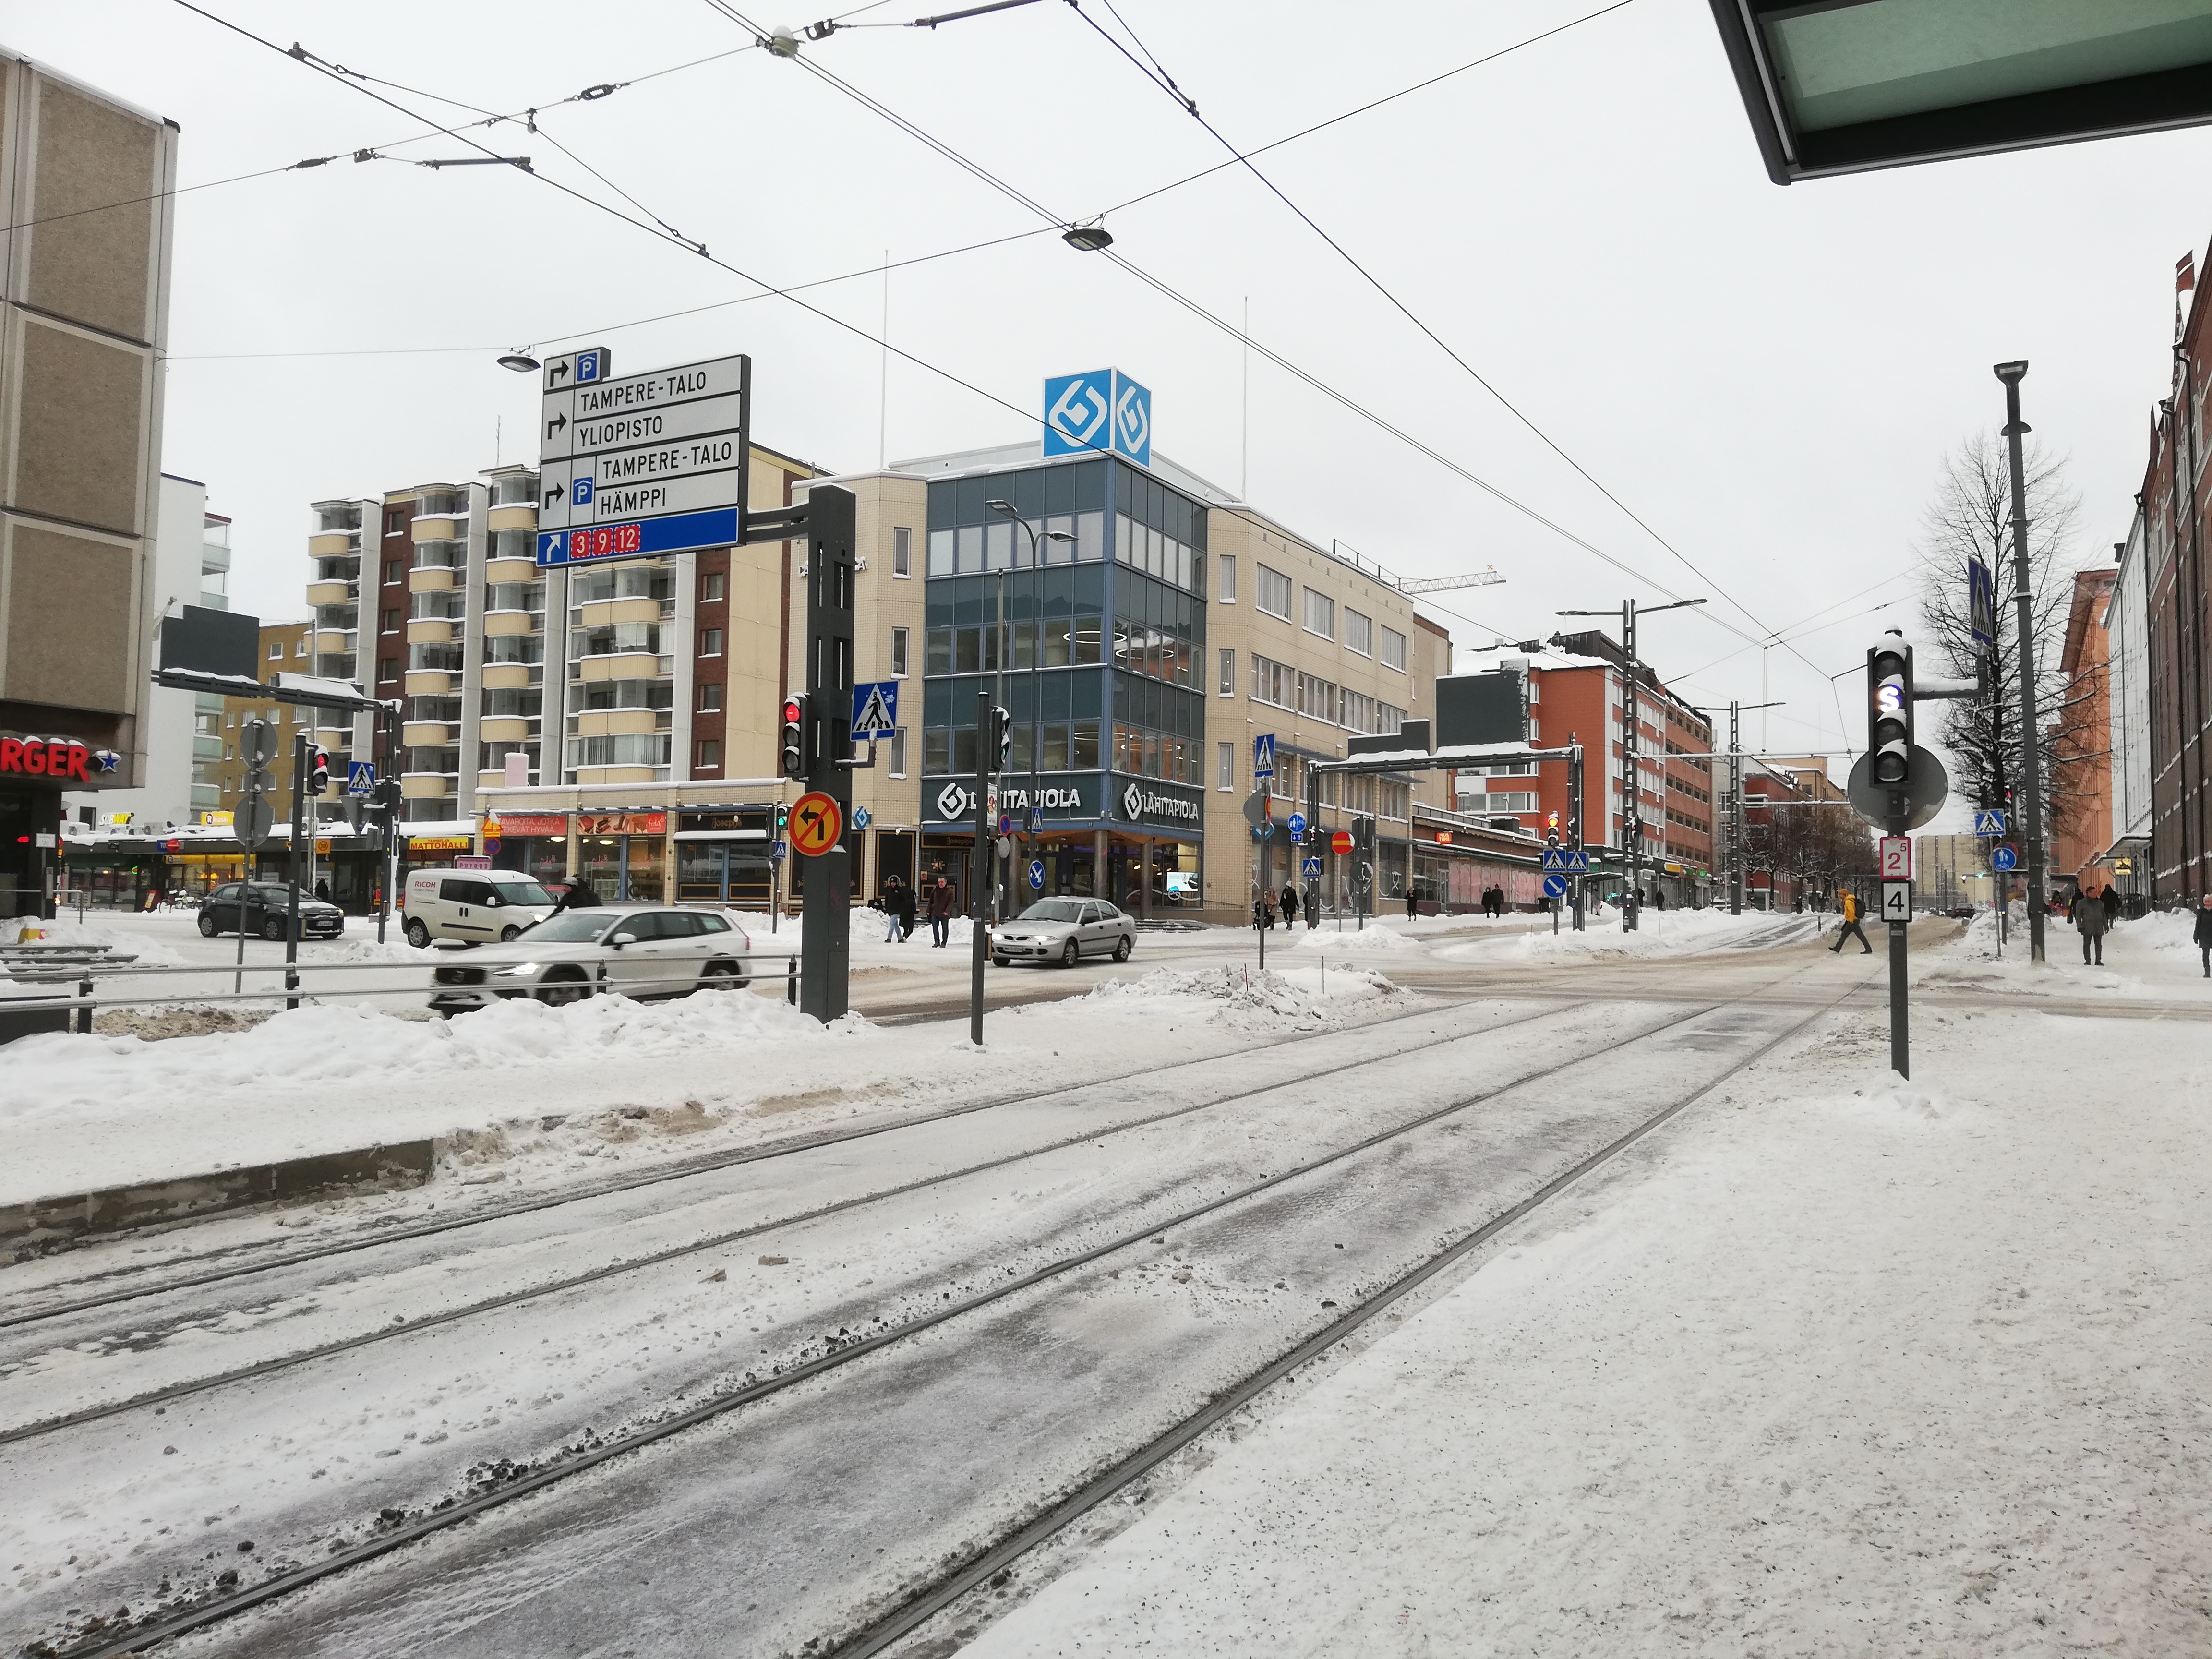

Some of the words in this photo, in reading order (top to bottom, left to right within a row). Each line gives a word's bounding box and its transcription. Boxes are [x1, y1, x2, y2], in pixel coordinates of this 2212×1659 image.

[582, 361, 592, 379] P
[581, 371, 706, 412] TAMPERE-TALO
[579, 415, 663, 447] YLIOPISTO
[603, 441, 732, 480] TAMPERE-TALO
[577, 486, 588, 503] P
[601, 487, 666, 515] HÄMPPI
[577, 535, 586, 554] 3
[599, 532, 607, 551] 9
[620, 529, 635, 549] 12
[1880, 686, 1899, 713] S
[0, 738, 91, 782] RGER
[1143, 791, 1199, 821] LÄHITAPIOLA
[98, 812, 134, 826] SUBWAY
[410, 842, 468, 850] MATTOHALLI
[1899, 843, 1907, 852] 5
[1887, 852, 1901, 870] 2
[1887, 890, 1905, 913] 4
